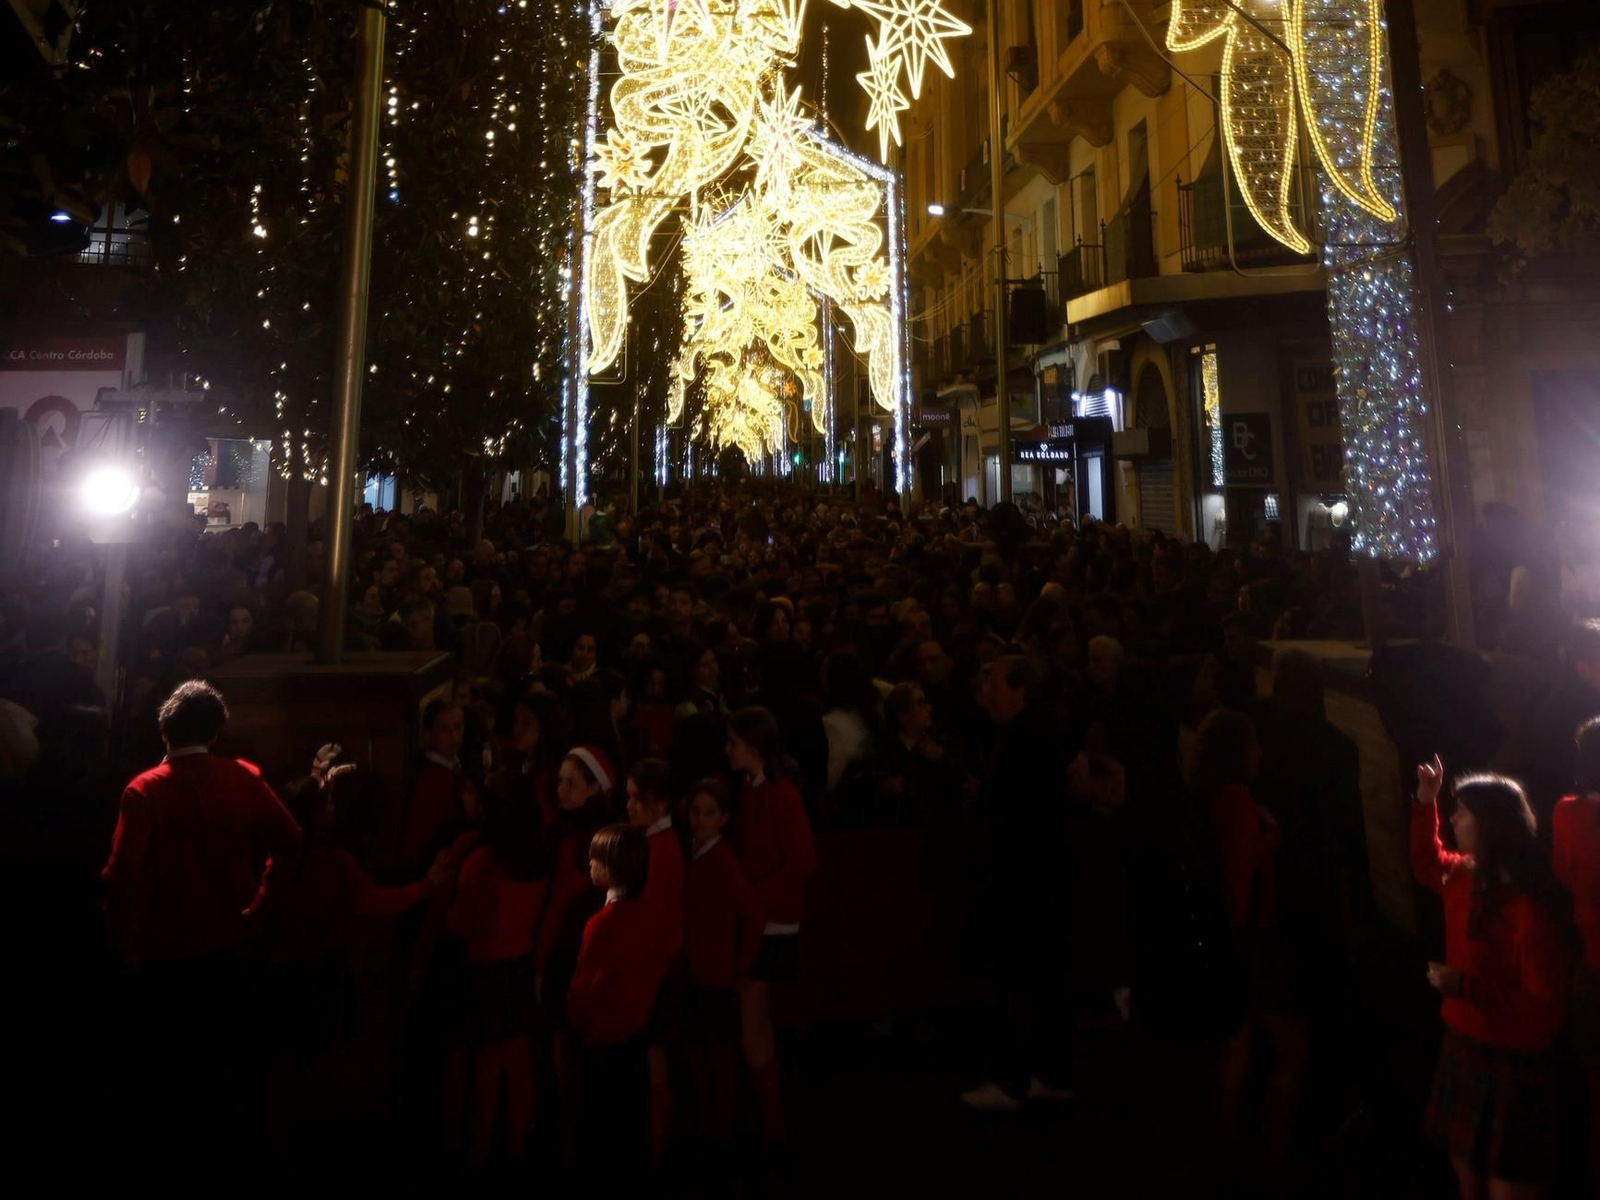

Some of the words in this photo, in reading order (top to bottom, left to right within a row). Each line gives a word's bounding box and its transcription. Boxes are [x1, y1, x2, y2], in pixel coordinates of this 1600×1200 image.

[28, 350, 64, 360] Centro
[68, 349, 114, 360] Córdoba
[1036, 451, 1069, 459] SOLDADO
